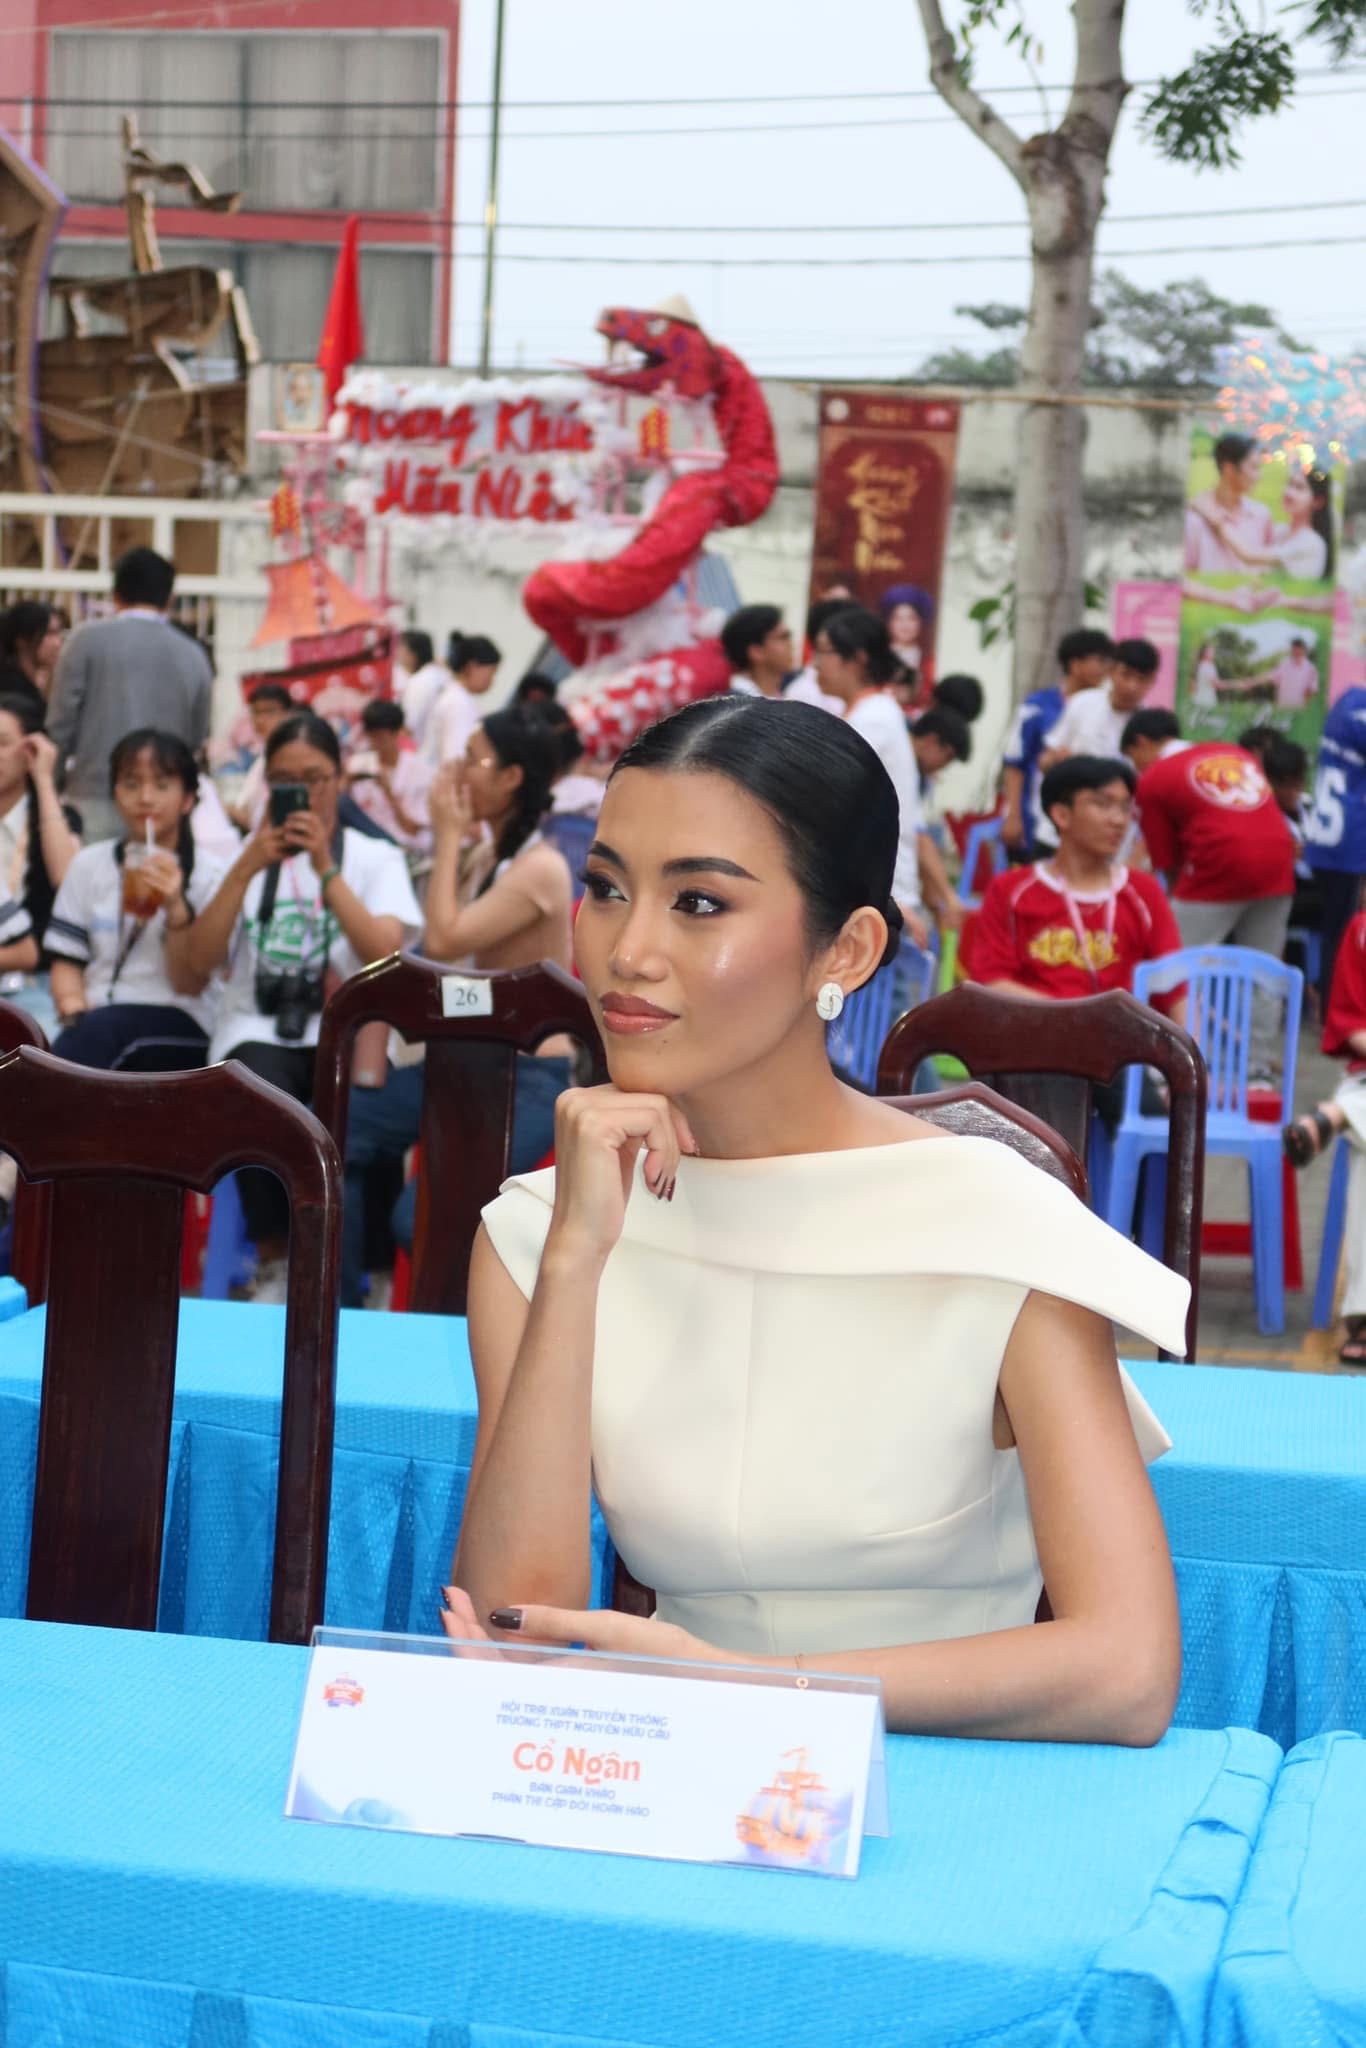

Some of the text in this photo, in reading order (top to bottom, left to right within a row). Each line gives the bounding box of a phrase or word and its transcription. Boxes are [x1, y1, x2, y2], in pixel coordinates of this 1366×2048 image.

[455, 986, 478, 1007] 26
[544, 1718, 570, 1731] THPT
[562, 1746, 641, 1785] Ngân
